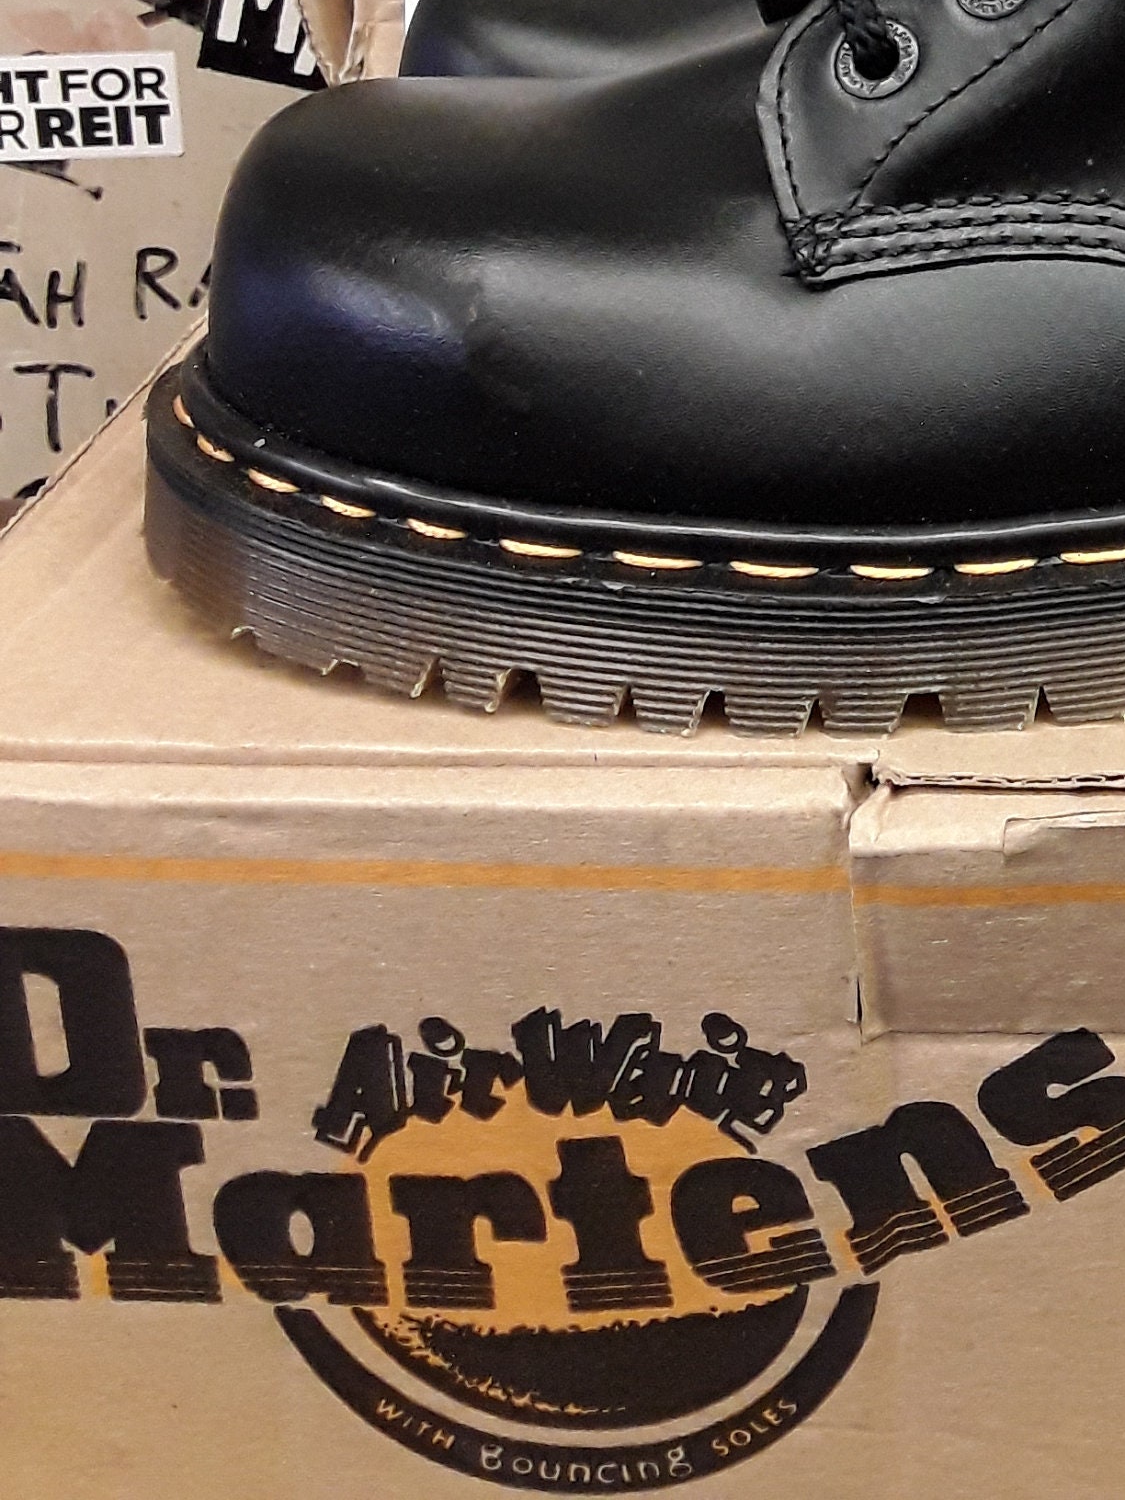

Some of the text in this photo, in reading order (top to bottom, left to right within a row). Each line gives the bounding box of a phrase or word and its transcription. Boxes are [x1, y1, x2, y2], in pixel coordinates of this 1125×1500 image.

[60, 67, 166, 102] FOR
[35, 104, 170, 149] REIT
[311, 1006, 808, 1164] AirWair
[375, 1397, 798, 1485] WITH Bouncing SOLES
